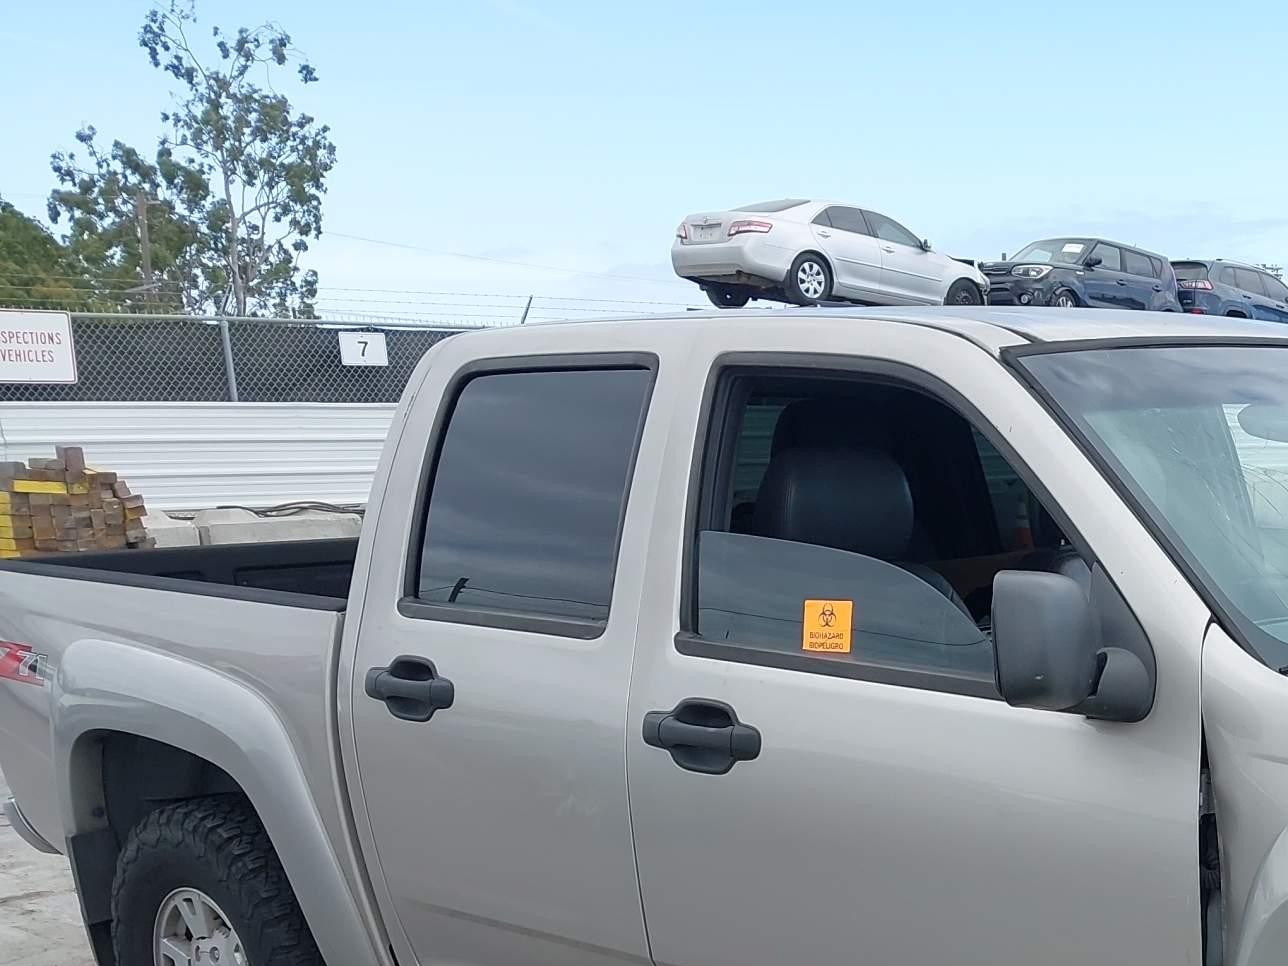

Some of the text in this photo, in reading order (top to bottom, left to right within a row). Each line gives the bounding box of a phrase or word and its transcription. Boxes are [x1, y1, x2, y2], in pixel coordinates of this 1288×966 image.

[0, 331, 62, 345] SPECTIONS
[0, 349, 55, 363] VEHICLES
[357, 341, 369, 357] 7
[809, 631, 844, 640] BIOHAZARD
